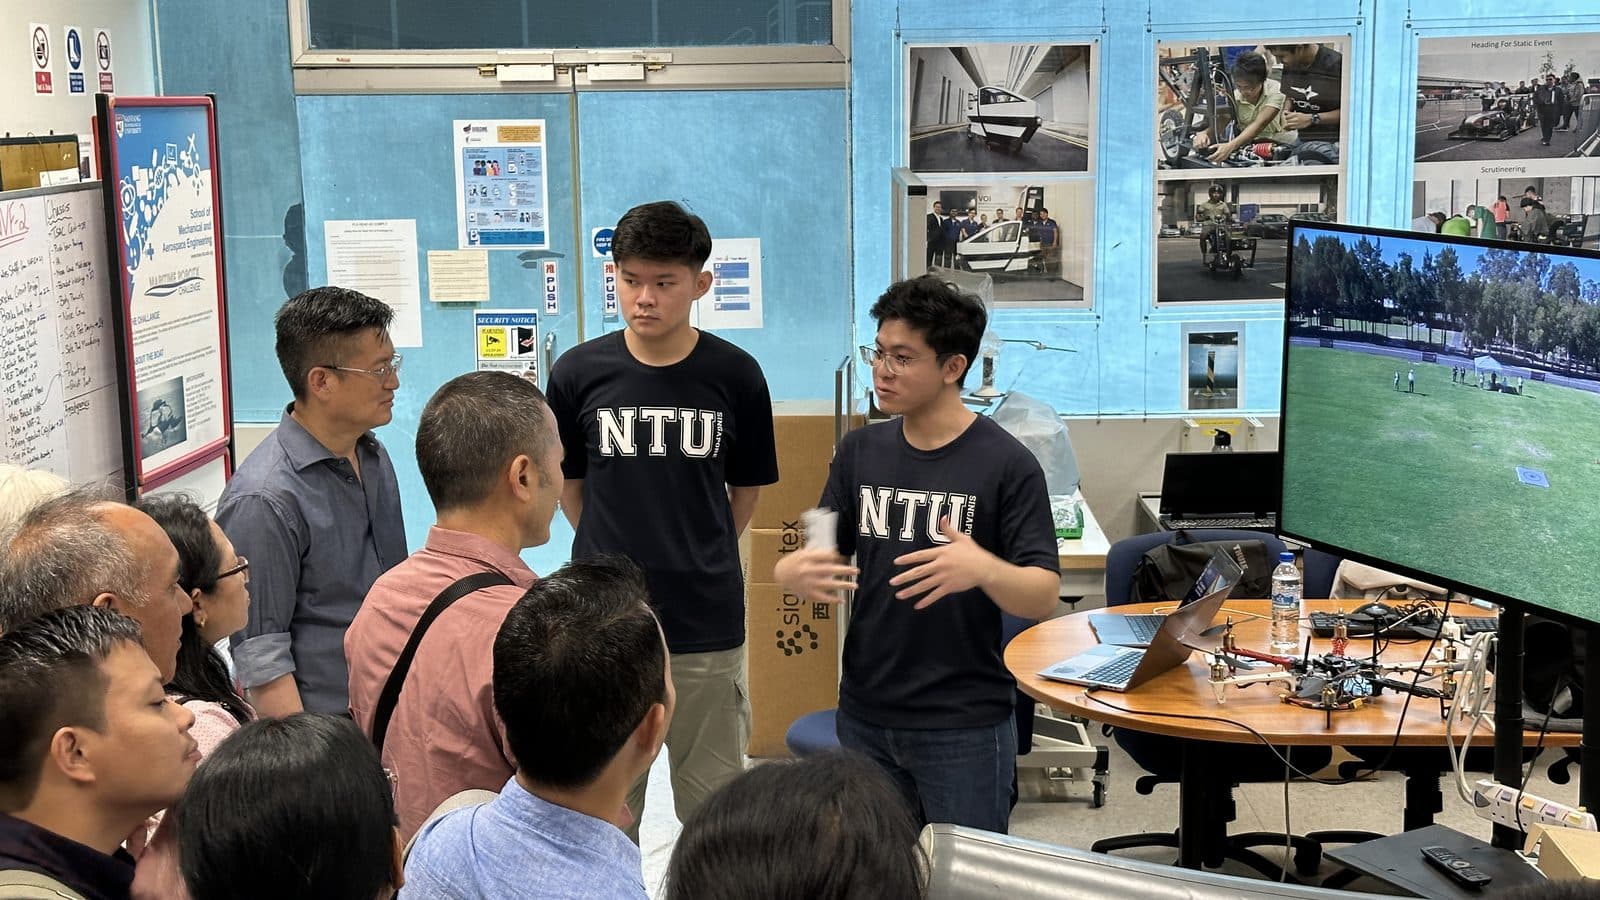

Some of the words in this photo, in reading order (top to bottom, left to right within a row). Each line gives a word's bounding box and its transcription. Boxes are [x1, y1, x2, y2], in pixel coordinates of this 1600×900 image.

[1471, 41, 1499, 49] Heading
[1501, 40, 1512, 48] For
[1533, 39, 1553, 47] Event
[1480, 166, 1526, 174] Scrutineering
[190, 208, 204, 219] School
[205, 206, 211, 217] of
[178, 221, 203, 235] Mechanical
[203, 221, 212, 232] and
[162, 240, 186, 254] Aerospace
[186, 236, 213, 250] Engineering
[546, 277, 556, 309] PUSH
[606, 277, 616, 309] PUSH
[597, 407, 717, 458] NTU
[712, 411, 723, 459] SINGAPORE
[858, 485, 968, 545] NTU
[964, 494, 977, 536] SINGAPO
[1232, 543, 1249, 570] THULE
